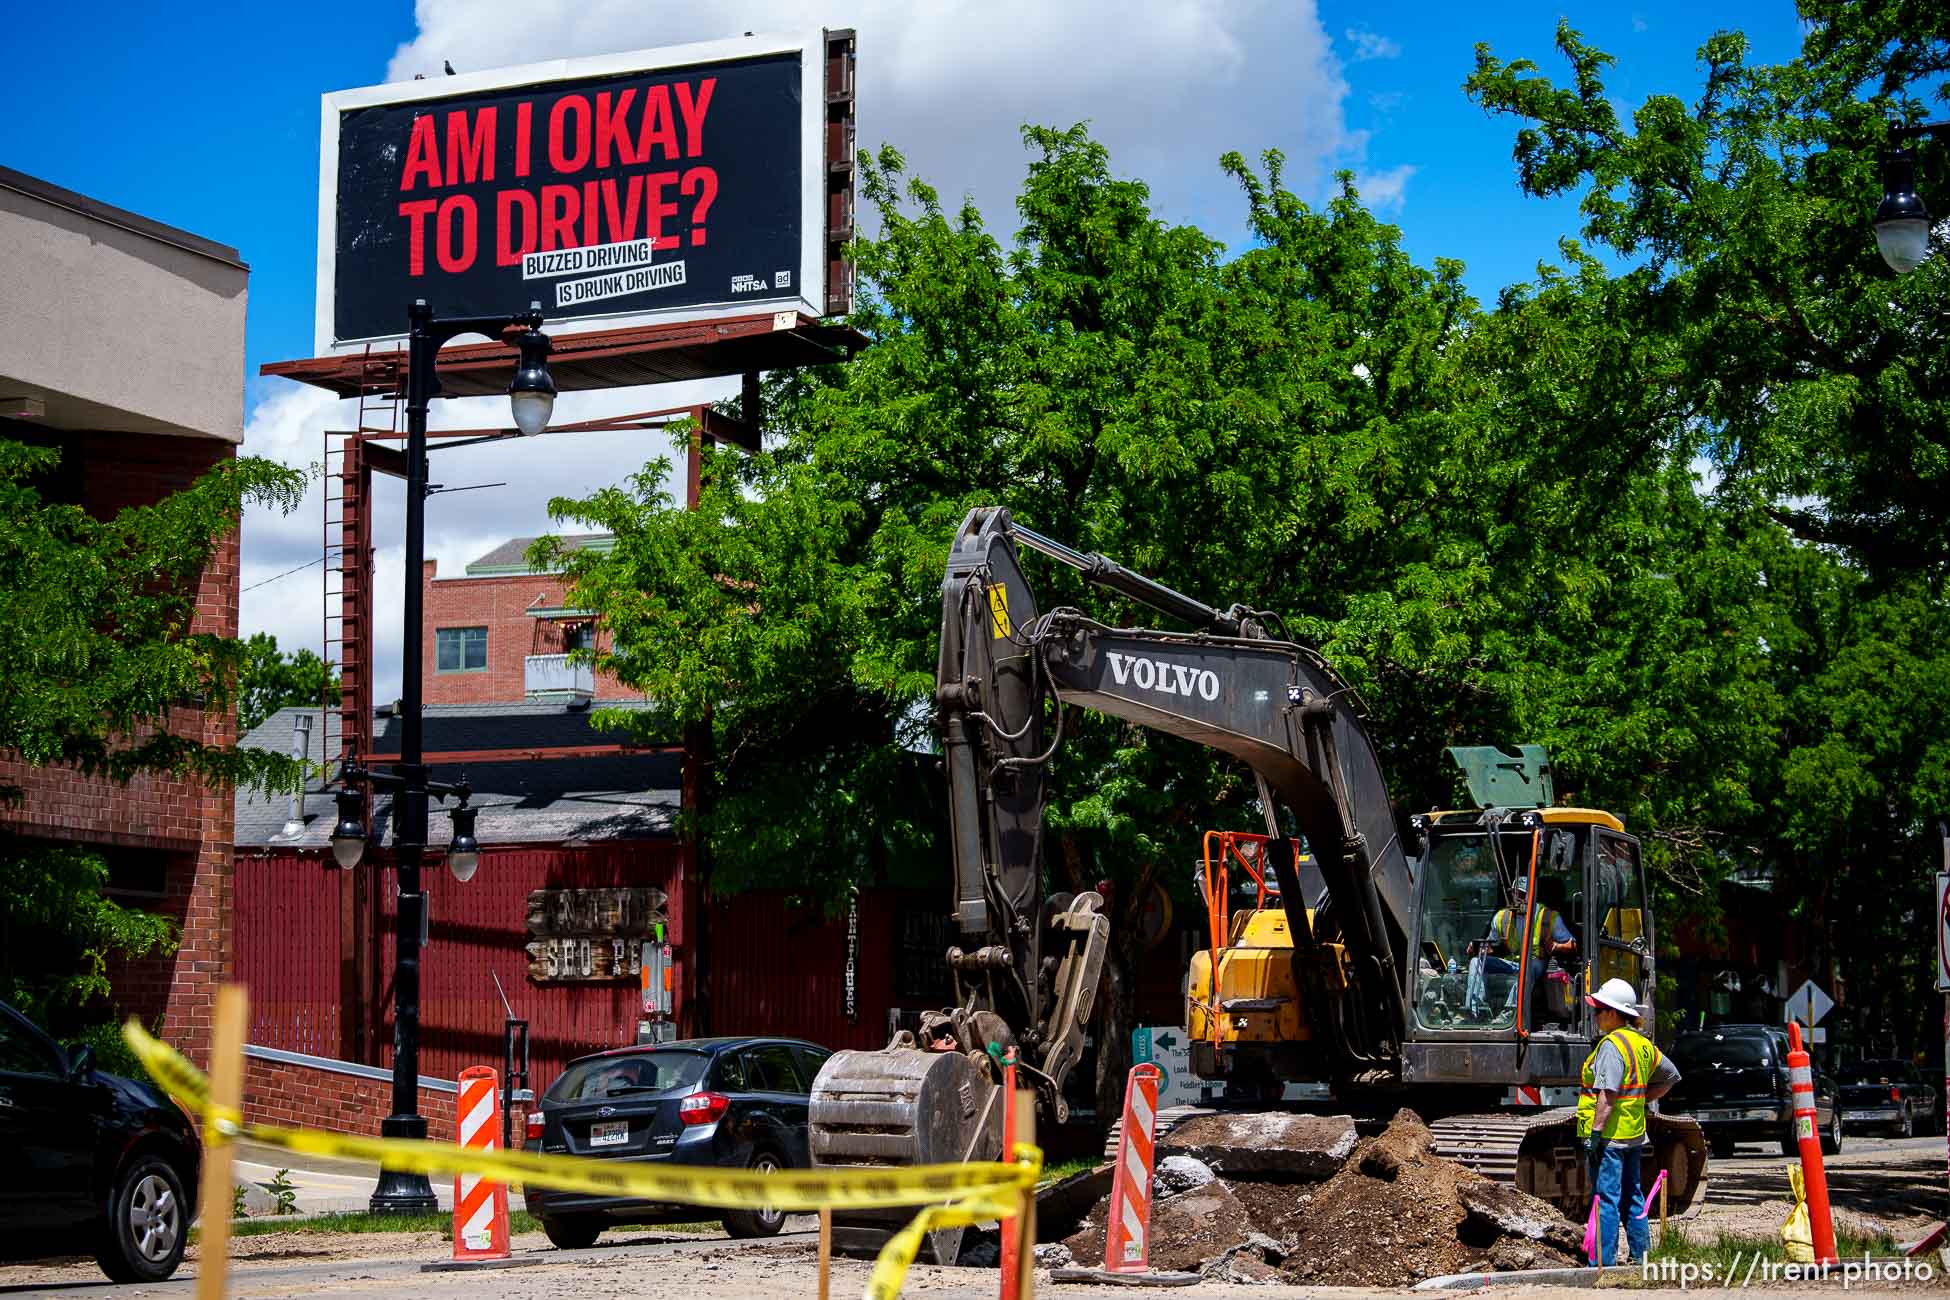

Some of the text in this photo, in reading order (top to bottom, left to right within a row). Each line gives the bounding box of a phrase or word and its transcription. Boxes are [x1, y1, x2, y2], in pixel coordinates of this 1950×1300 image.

[400, 78, 718, 191] AM I OKAY
[399, 166, 719, 276] TO DRIVE?
[526, 242, 649, 276] BUZZED DRIVING
[559, 264, 683, 303] IS DRUNK DRIVING
[731, 280, 768, 293] NHTSA
[1106, 652, 1219, 701] VOLVO
